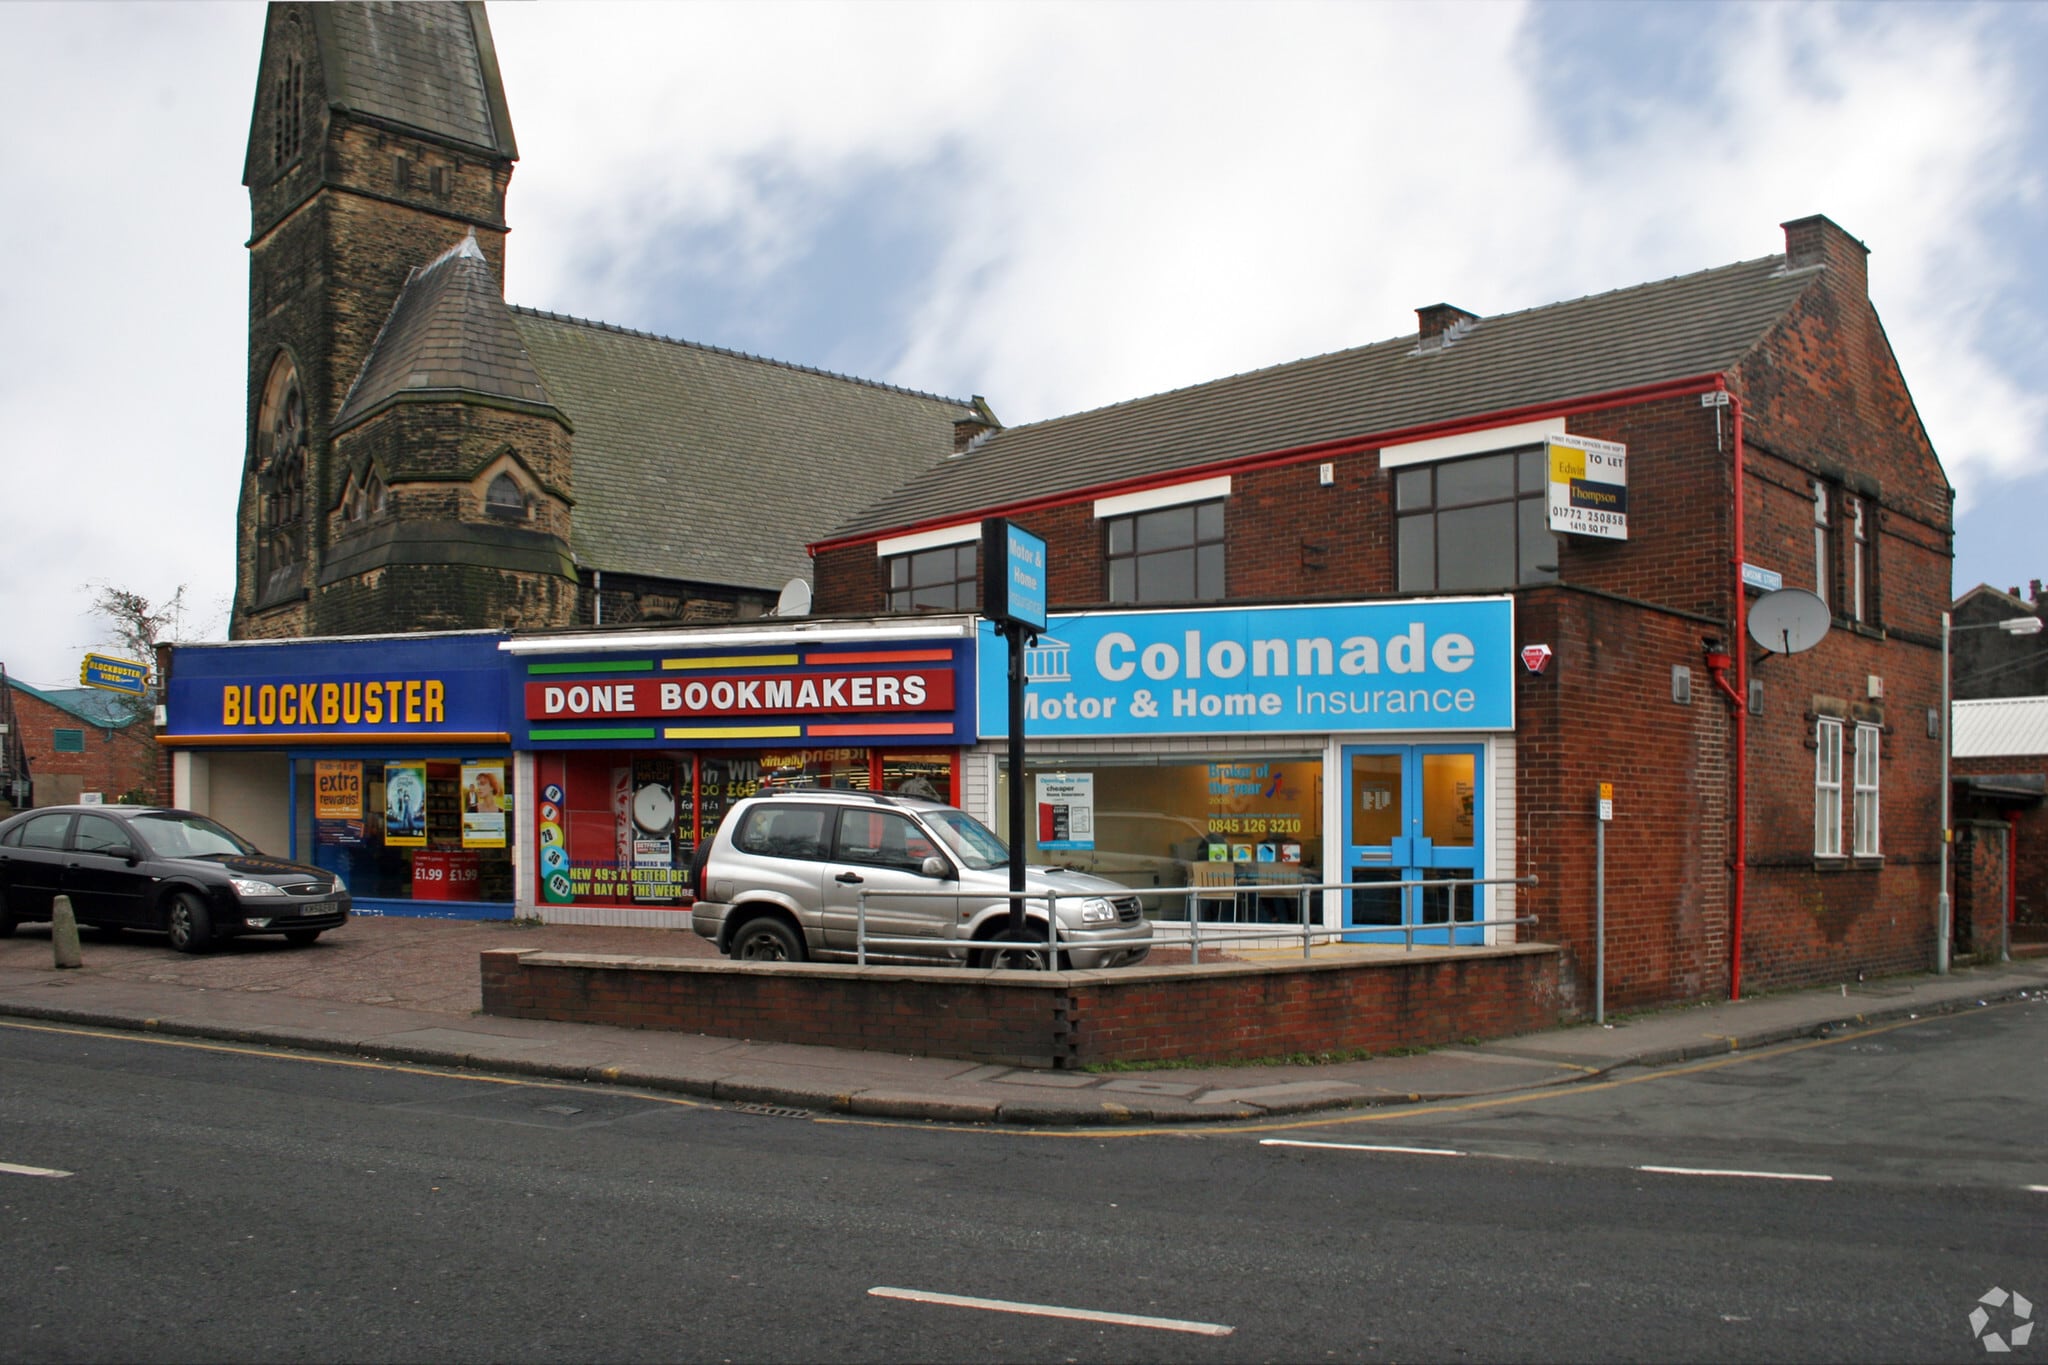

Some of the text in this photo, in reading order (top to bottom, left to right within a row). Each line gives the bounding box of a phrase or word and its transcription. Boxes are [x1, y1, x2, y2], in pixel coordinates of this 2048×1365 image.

[1559, 462, 1585, 475] Edwin
[1589, 453, 1623, 468] TO LET
[1571, 485, 1616, 504] Thompson
[1553, 506, 1624, 526] 01772 250858
[1588, 525, 1598, 533] SQ
[1600, 526, 1608, 534] FT
[1009, 538, 1042, 568] Motor &
[1014, 566, 1037, 590] Home
[1095, 622, 1475, 682] Colonnade
[88, 661, 141, 678] BLOCKBUSTER
[100, 673, 121, 682] VIDEO
[223, 680, 444, 725] BLOCKBUSTER
[544, 675, 927, 714] DONE BOOKMAKERS
[1129, 689, 1159, 718] &
[1172, 688, 1282, 717] Home
[1296, 685, 1476, 715] Insurance
[760, 754, 804, 769] virtually
[1209, 762, 1270, 779] Broker of
[320, 772, 358, 792] extra
[1046, 784, 1075, 792] cheaper
[1209, 781, 1262, 798] the year
[320, 793, 359, 806] rewards!
[1208, 820, 1301, 833] 0845 126 3210
[414, 867, 478, 881] £1.99 £1.99
[570, 868, 592, 880] NEW
[620, 869, 628, 881] A
[631, 869, 666, 882] BETTER
[670, 870, 689, 882] BET
[571, 883, 682, 897] ANY DAY OF THE WEEK
